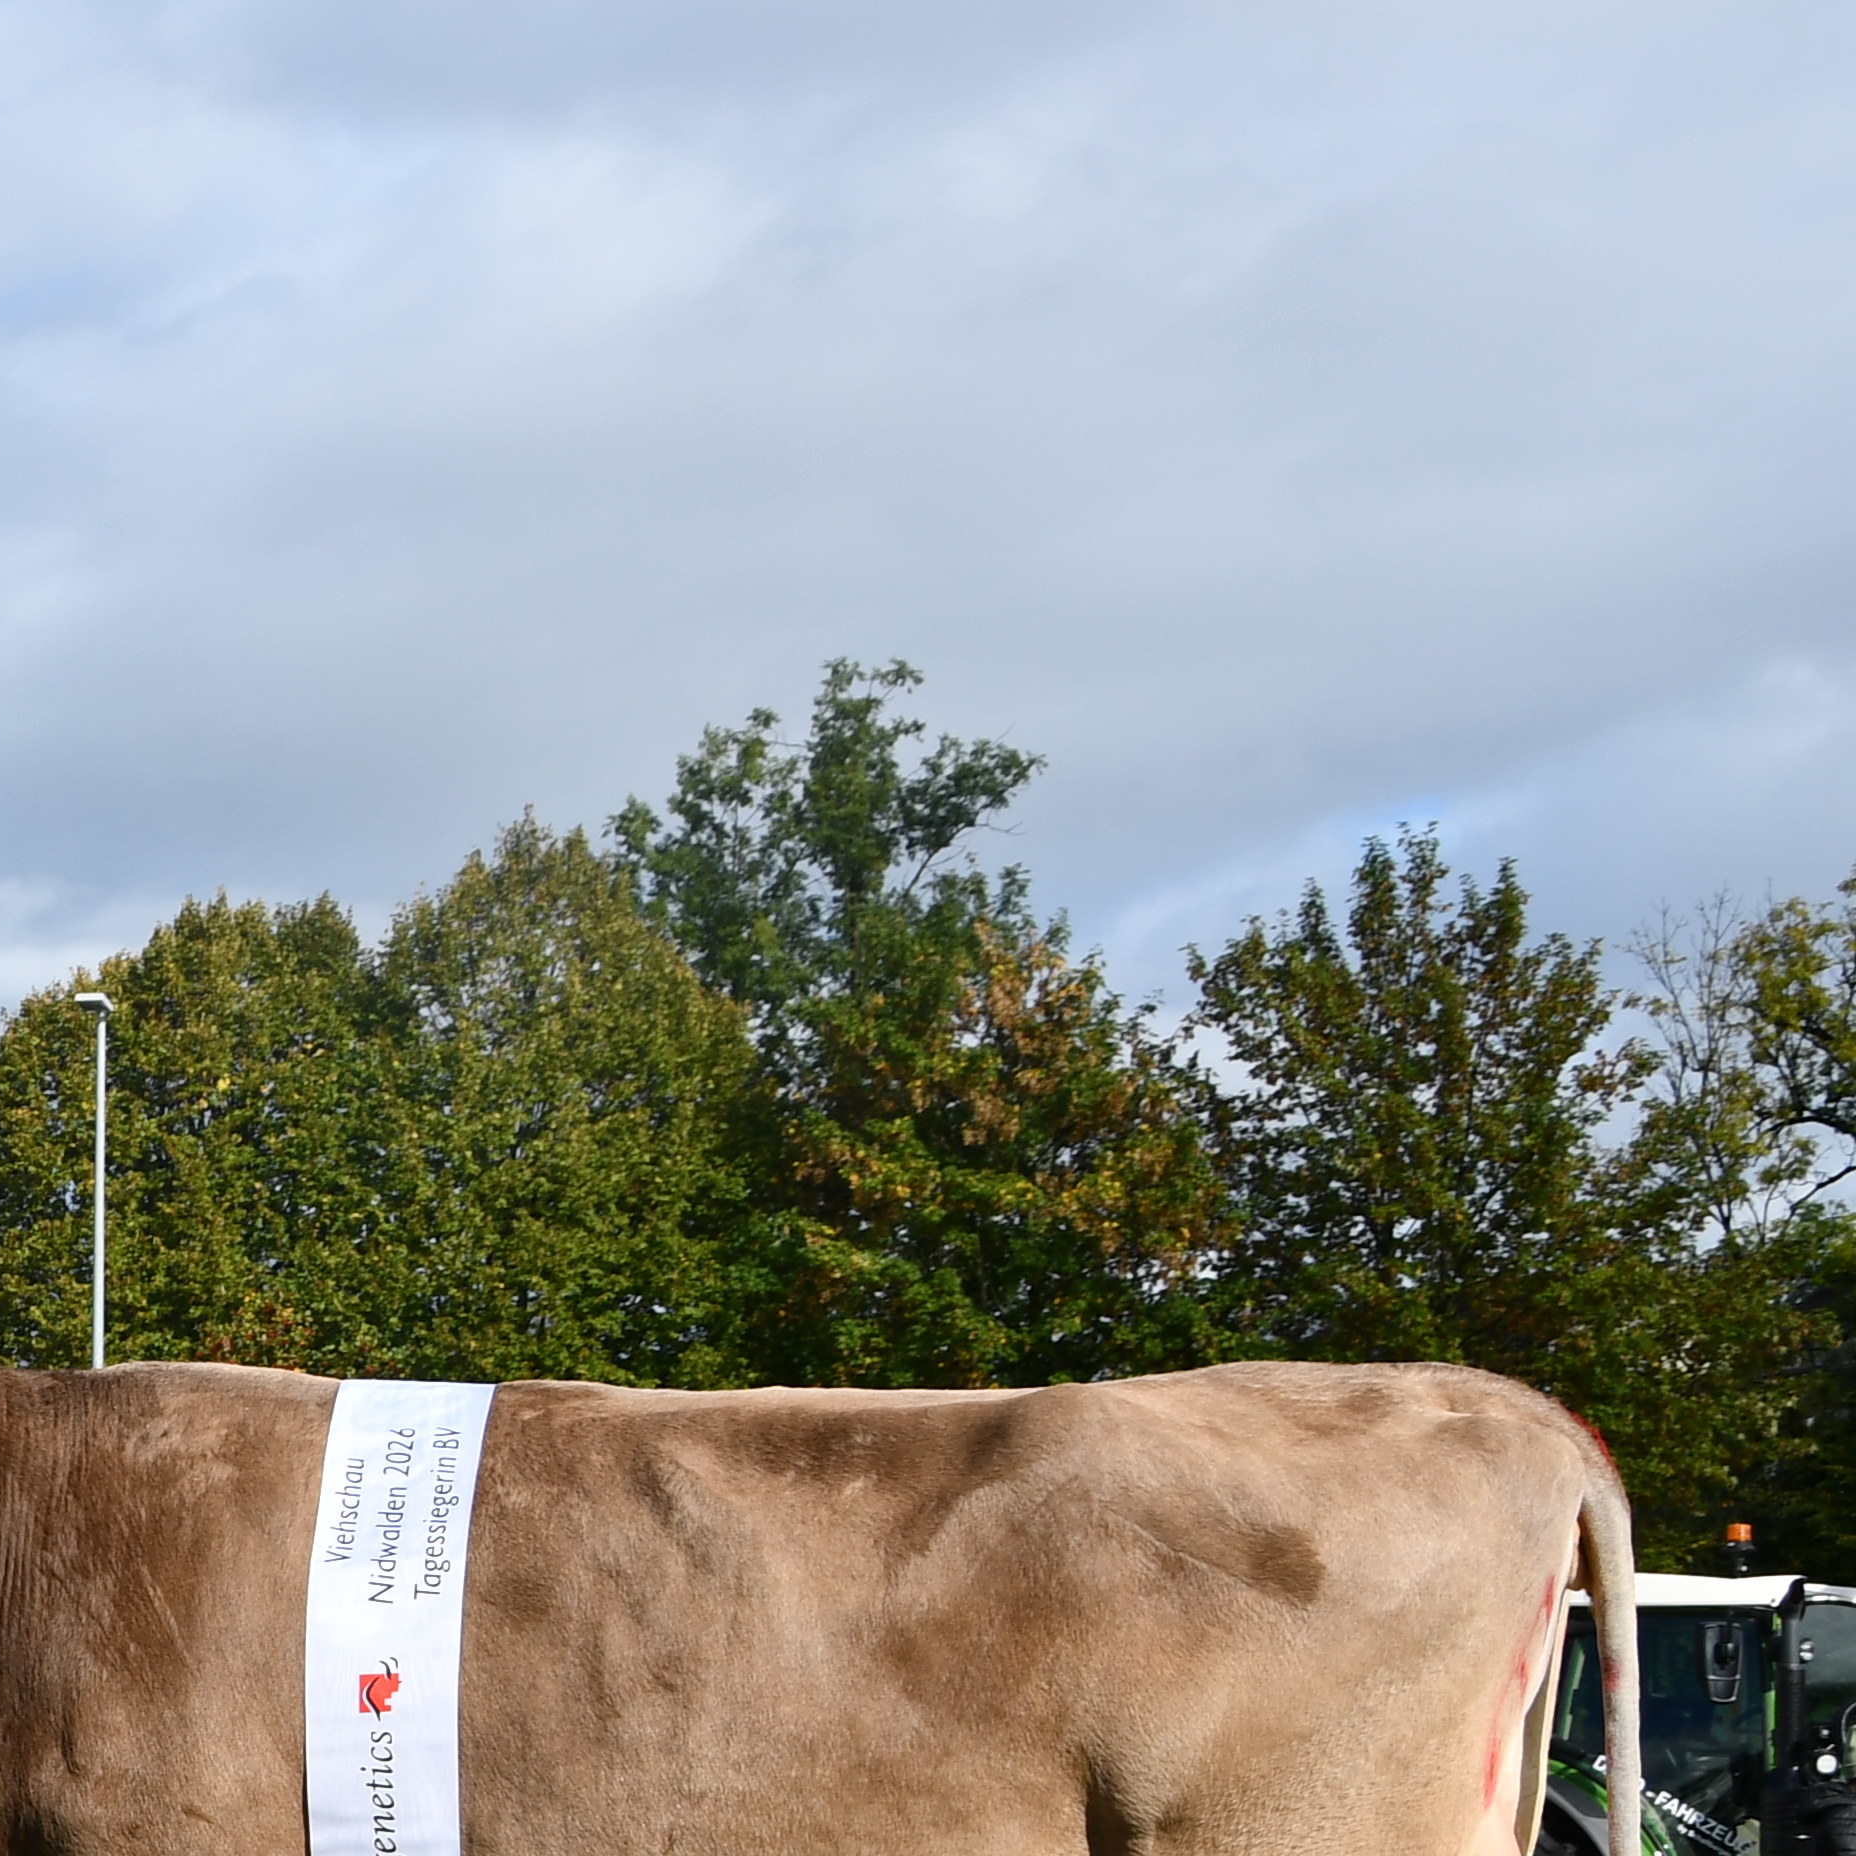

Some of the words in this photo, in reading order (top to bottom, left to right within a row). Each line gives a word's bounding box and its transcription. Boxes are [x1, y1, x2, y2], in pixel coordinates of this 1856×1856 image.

[383, 1427, 415, 1477] 2026
[433, 1427, 461, 1449] BV
[324, 1458, 364, 1562] Viehschau
[368, 1486, 407, 1603] Nidwalden
[414, 1457, 459, 1600] Tagessiegerin
